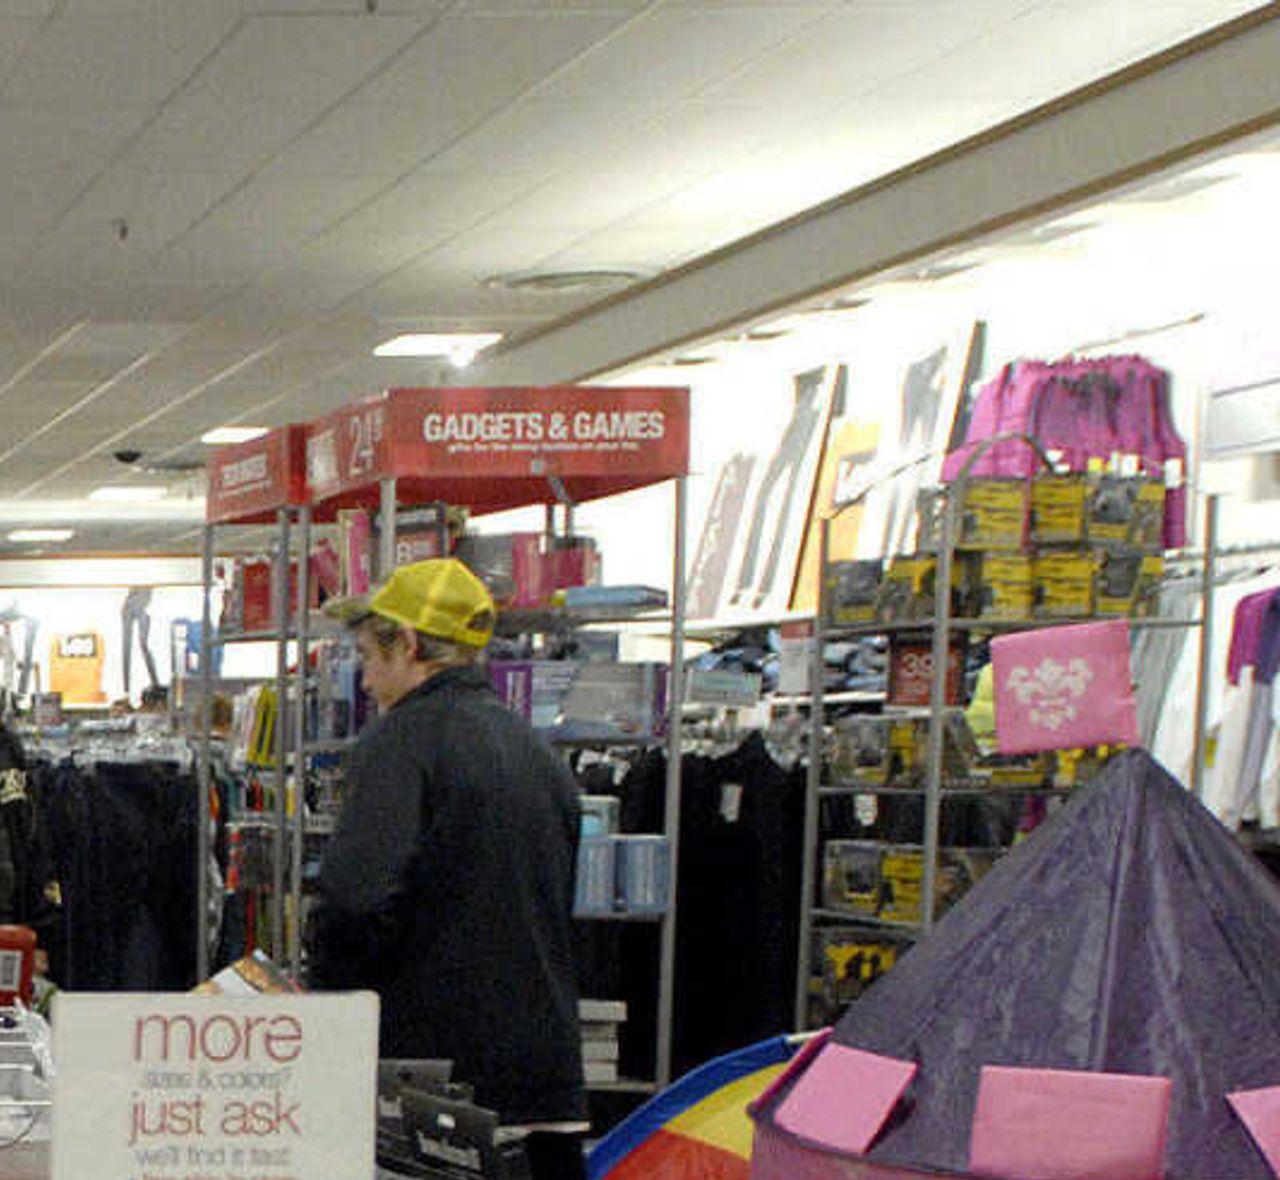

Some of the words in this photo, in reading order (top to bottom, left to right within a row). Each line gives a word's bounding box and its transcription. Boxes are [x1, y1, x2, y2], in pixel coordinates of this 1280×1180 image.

[423, 413, 543, 441] GADGETS
[548, 413, 568, 439] &
[573, 412, 665, 438] GAMES
[134, 1014, 303, 1062] more
[128, 1091, 206, 1147] just
[221, 1092, 302, 1136] ask
